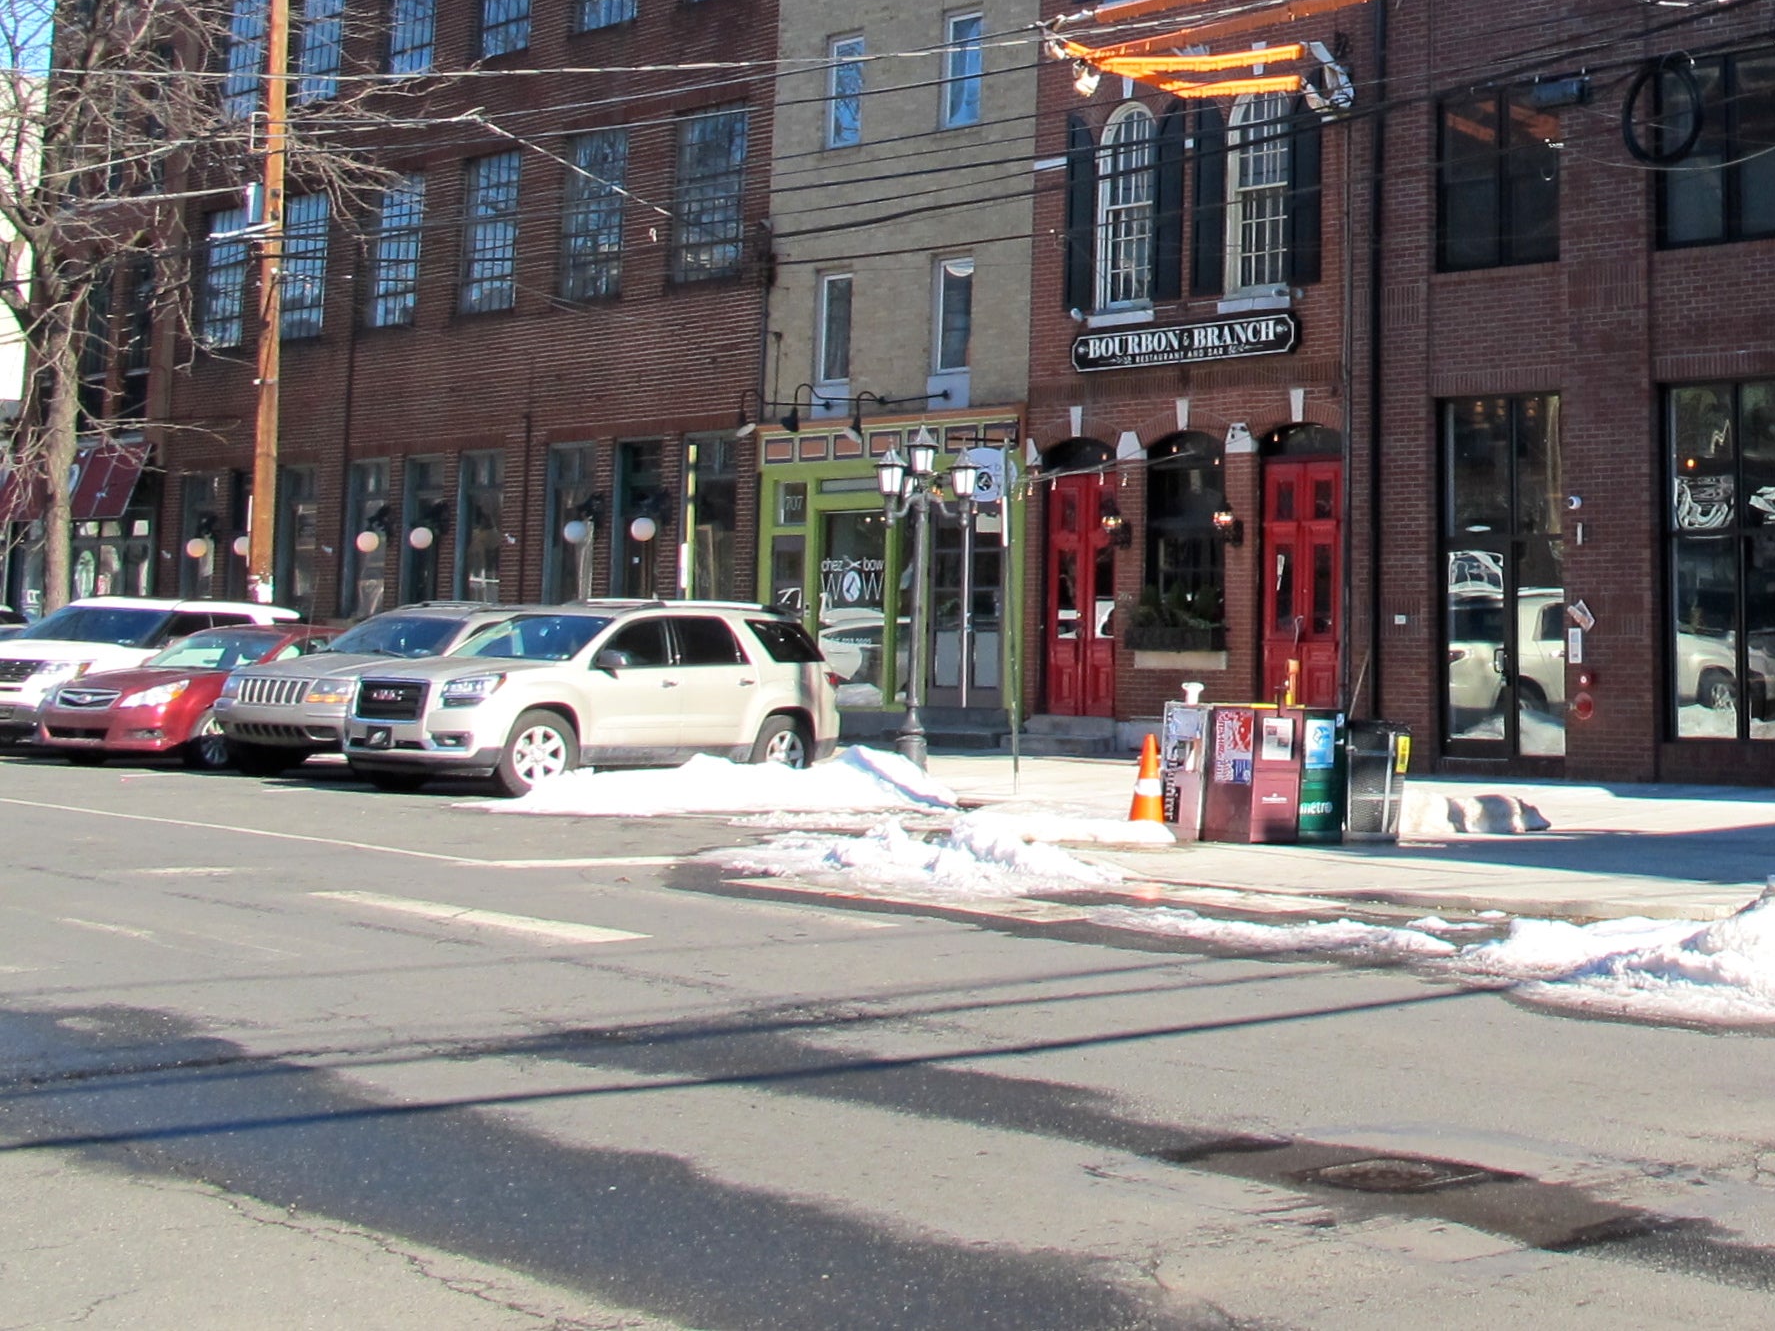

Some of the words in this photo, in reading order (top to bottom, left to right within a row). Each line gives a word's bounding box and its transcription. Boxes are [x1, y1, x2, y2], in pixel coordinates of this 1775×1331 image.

[1088, 331, 1180, 359] BOURBON
[1193, 320, 1276, 350] BRANCH
[1135, 351, 1185, 364] RESTAURANT
[1187, 349, 1205, 359] AND
[1207, 347, 1224, 357] BAR
[785, 495, 804, 511] 707
[821, 557, 844, 572] chez
[863, 556, 885, 571] bow
[820, 570, 885, 603] WOW
[1300, 801, 1334, 815] metro
